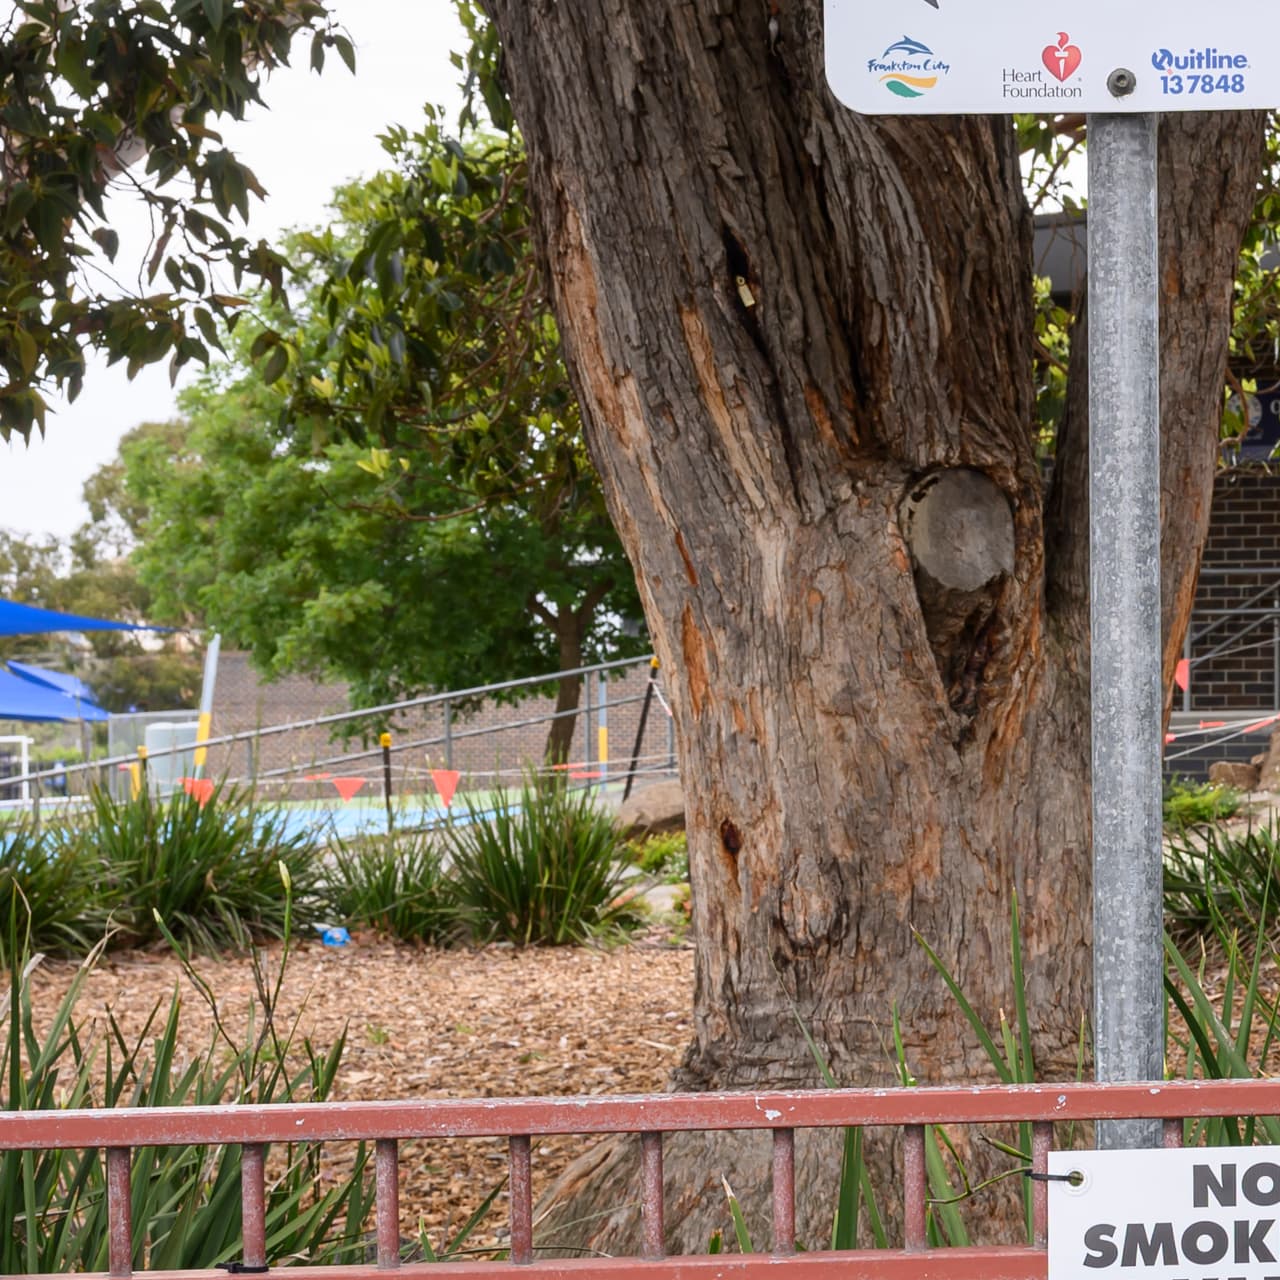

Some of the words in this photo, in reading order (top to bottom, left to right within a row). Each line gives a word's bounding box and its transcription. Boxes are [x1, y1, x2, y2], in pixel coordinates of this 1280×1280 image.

[867, 58, 921, 73] Frankston
[923, 58, 950, 75] City
[1151, 47, 1248, 71] Quitline
[1002, 68, 1042, 83] Heart
[1186, 73, 1246, 95] 7848
[1002, 83, 1082, 98] Foundation
